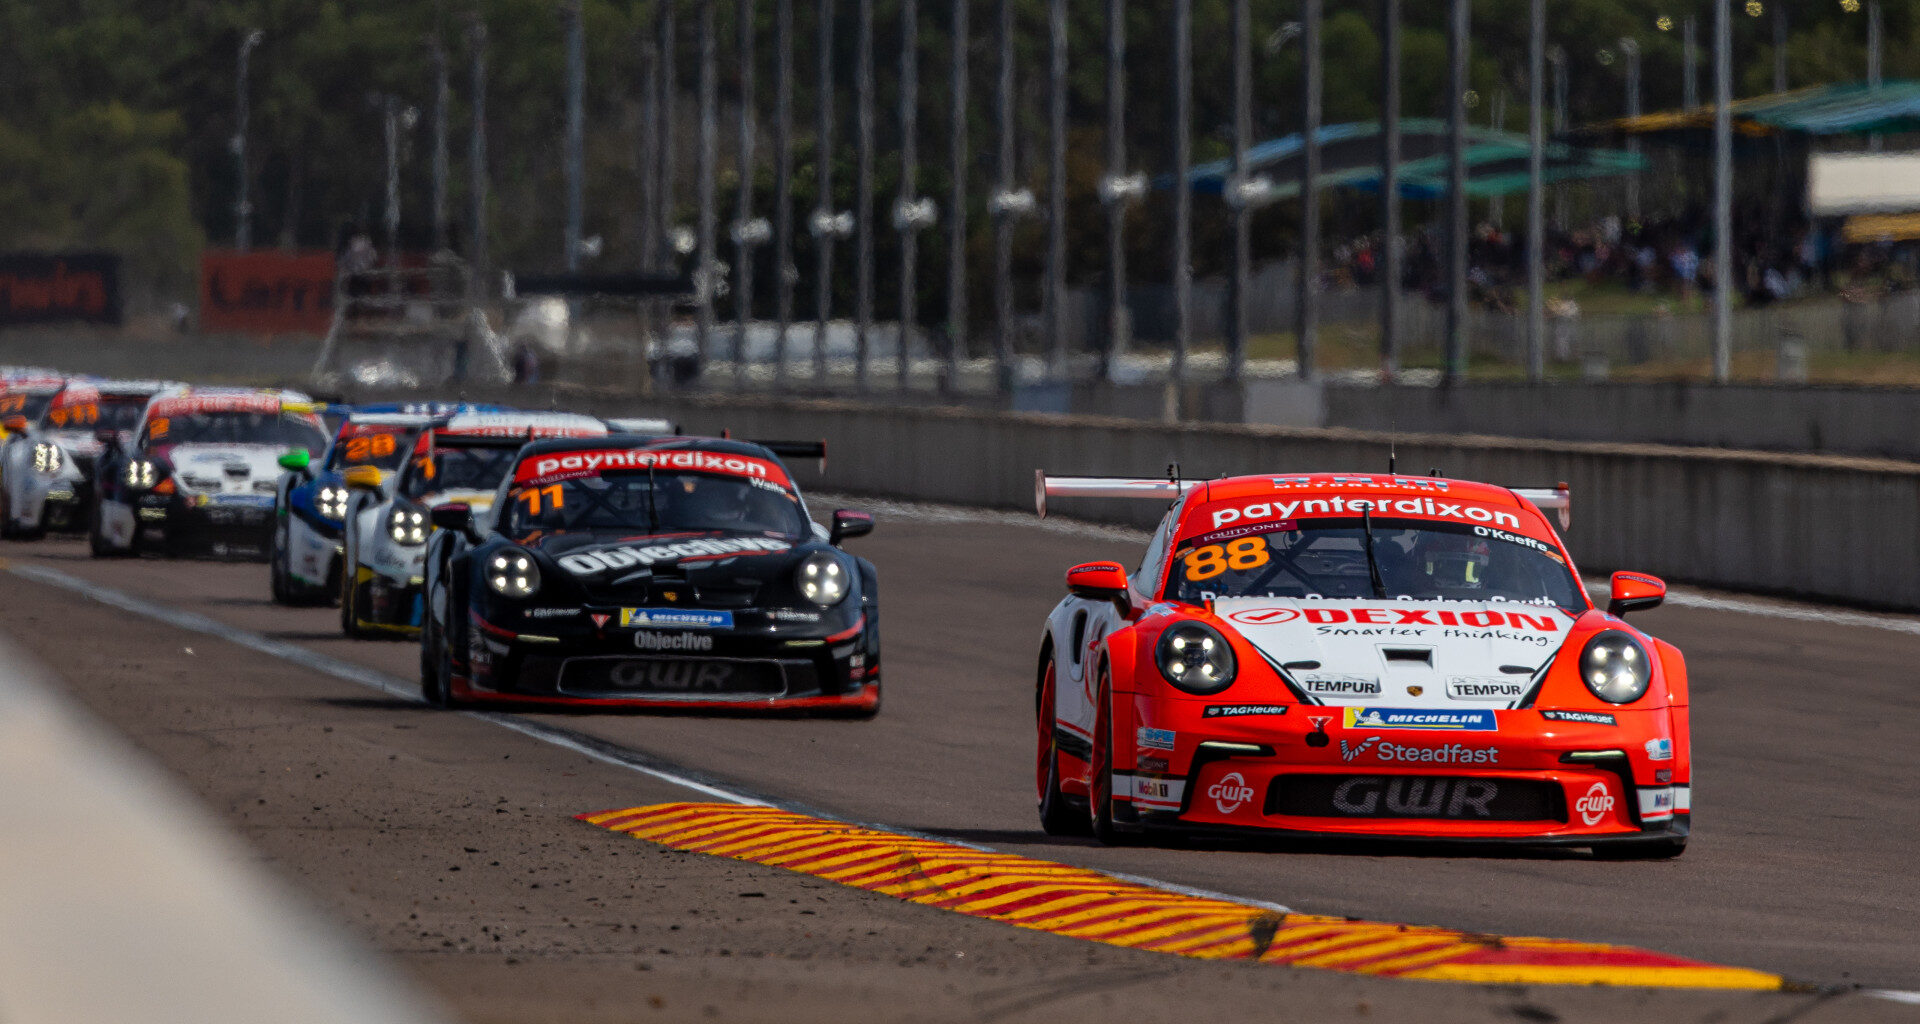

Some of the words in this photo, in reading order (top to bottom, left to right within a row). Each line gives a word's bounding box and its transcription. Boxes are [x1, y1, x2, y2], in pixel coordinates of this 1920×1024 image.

[537, 451, 766, 476] paynterdixon
[518, 484, 564, 516] 11
[1213, 496, 1520, 529] paynterdixon
[1474, 526, 1548, 551] O'Keeffe
[1184, 536, 1270, 581] 88
[1302, 608, 1558, 632] DEXION
[1316, 625, 1427, 636] Smarter
[634, 630, 713, 651] Objective
[1305, 680, 1375, 694] TEMPUR
[1453, 684, 1522, 696] TEMPUR
[1387, 714, 1483, 724] MICHELIN
[1376, 742, 1499, 764] Steadfast
[1207, 783, 1255, 803] GWR
[1332, 777, 1499, 816] GWR
[1575, 796, 1615, 812] GWR
